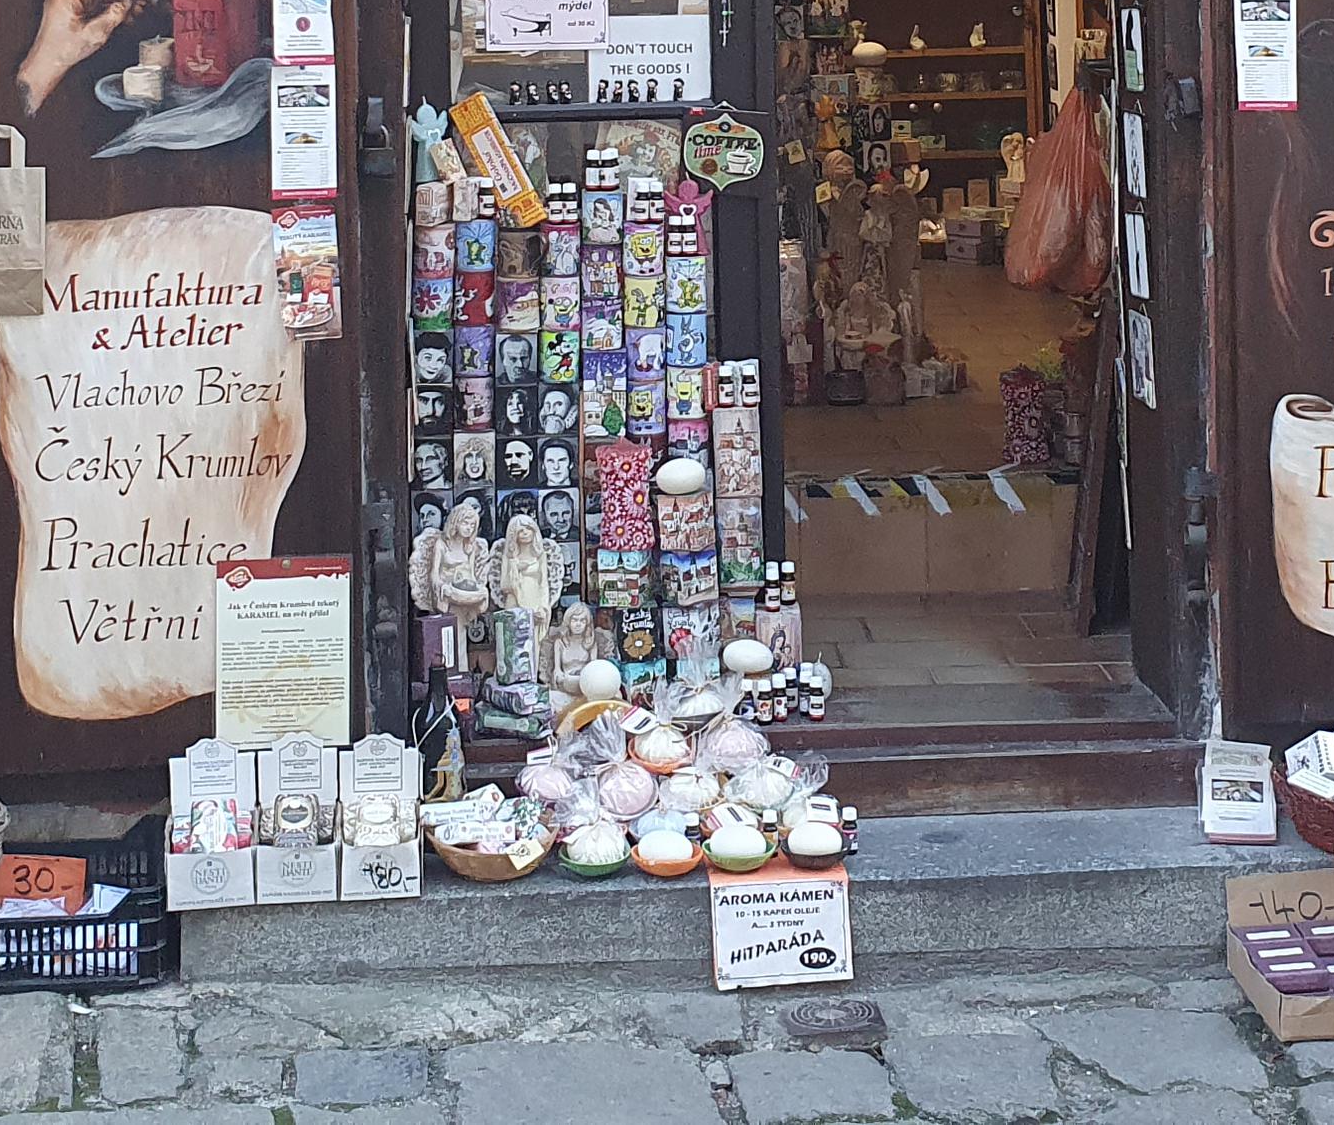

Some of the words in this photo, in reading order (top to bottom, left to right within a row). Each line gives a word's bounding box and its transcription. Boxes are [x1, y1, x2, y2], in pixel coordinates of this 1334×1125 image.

[558, 0, 592, 13] mýdel
[647, 43, 692, 53] TOUCH
[610, 64, 633, 75] THE
[637, 64, 681, 75] GOODS
[694, 146, 722, 159] time
[44, 271, 264, 313] Manufaktura
[91, 327, 113, 350] &
[121, 313, 246, 351] Atelier
[35, 370, 183, 411] Vlachovo
[35, 426, 143, 496] Český
[155, 433, 292, 479] Krumlov
[40, 517, 248, 572] Prachatice
[237, 611, 281, 619] KARAMEL
[719, 893, 776, 906] AROMA
[780, 889, 833, 902] KÁMEN
[803, 952, 835, 964] 190,-
